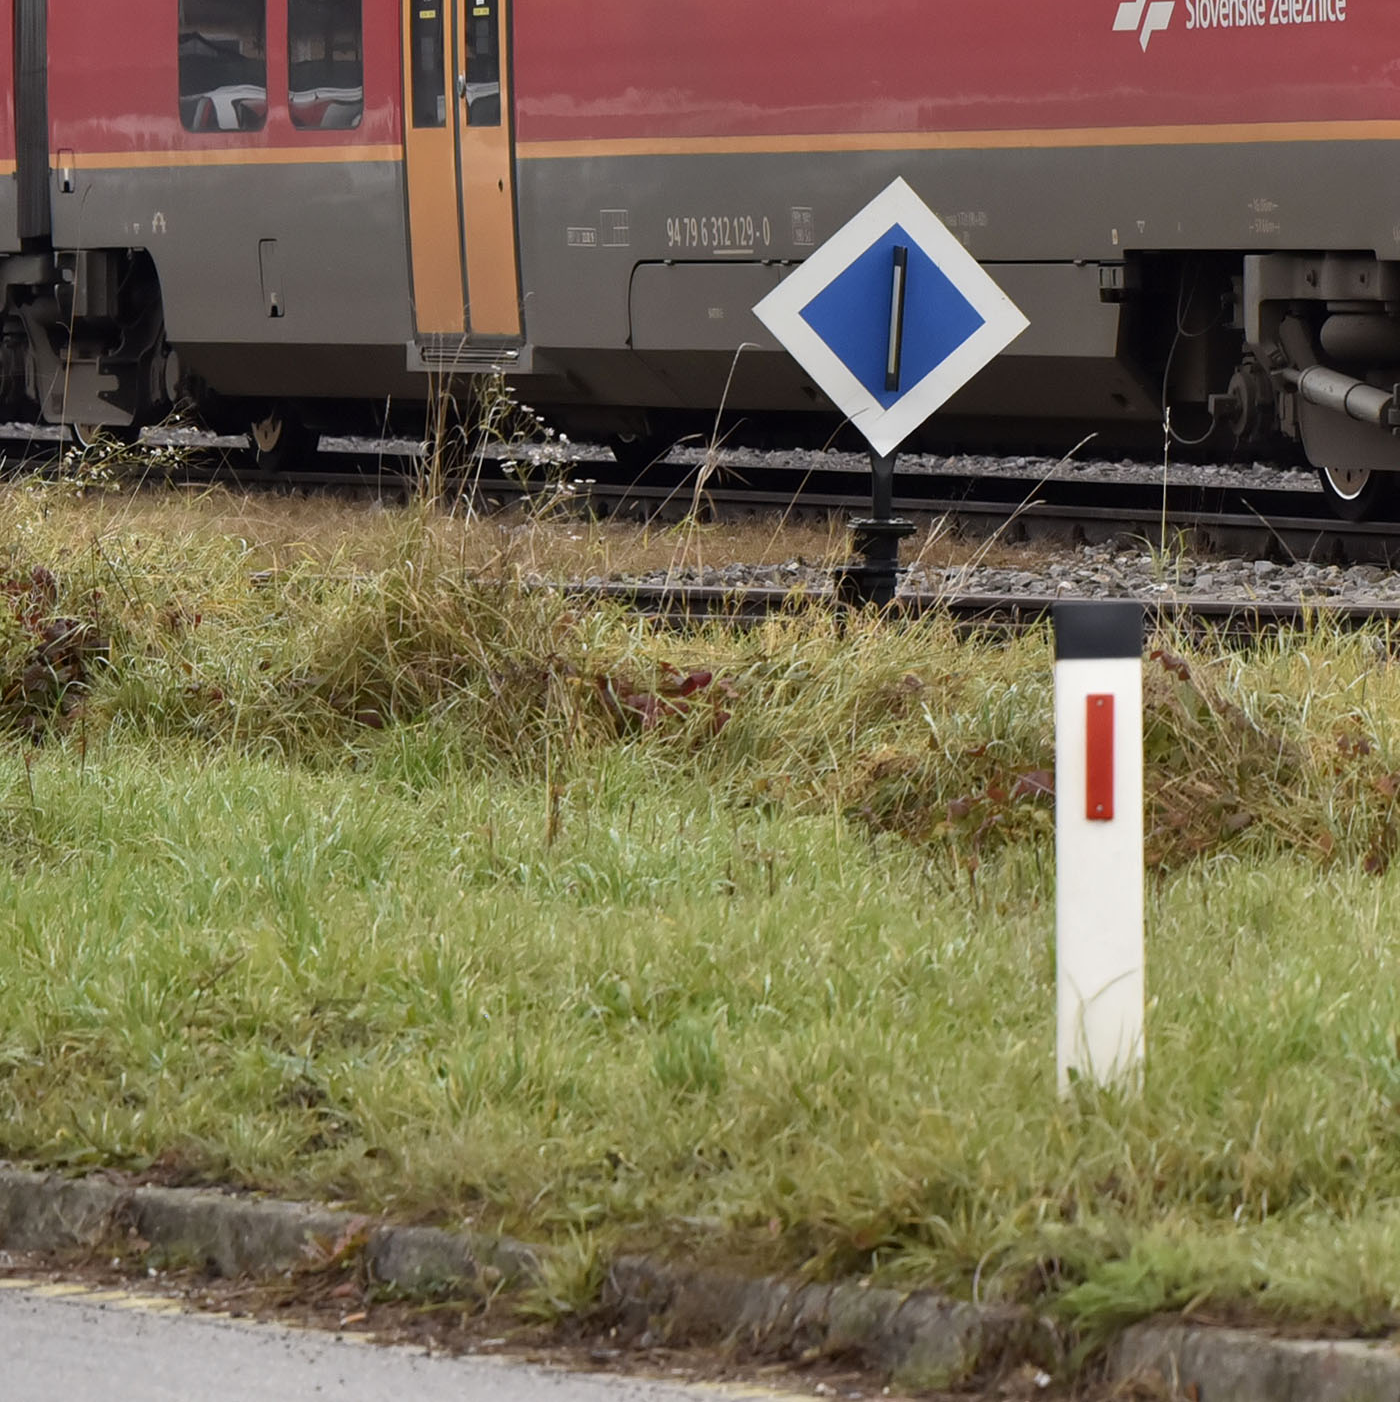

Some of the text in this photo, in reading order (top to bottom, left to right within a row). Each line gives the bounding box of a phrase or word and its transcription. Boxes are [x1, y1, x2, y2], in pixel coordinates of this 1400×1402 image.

[667, 217, 681, 247] 94
[684, 217, 698, 246] 79
[701, 217, 708, 246] 6
[711, 216, 731, 246] 312
